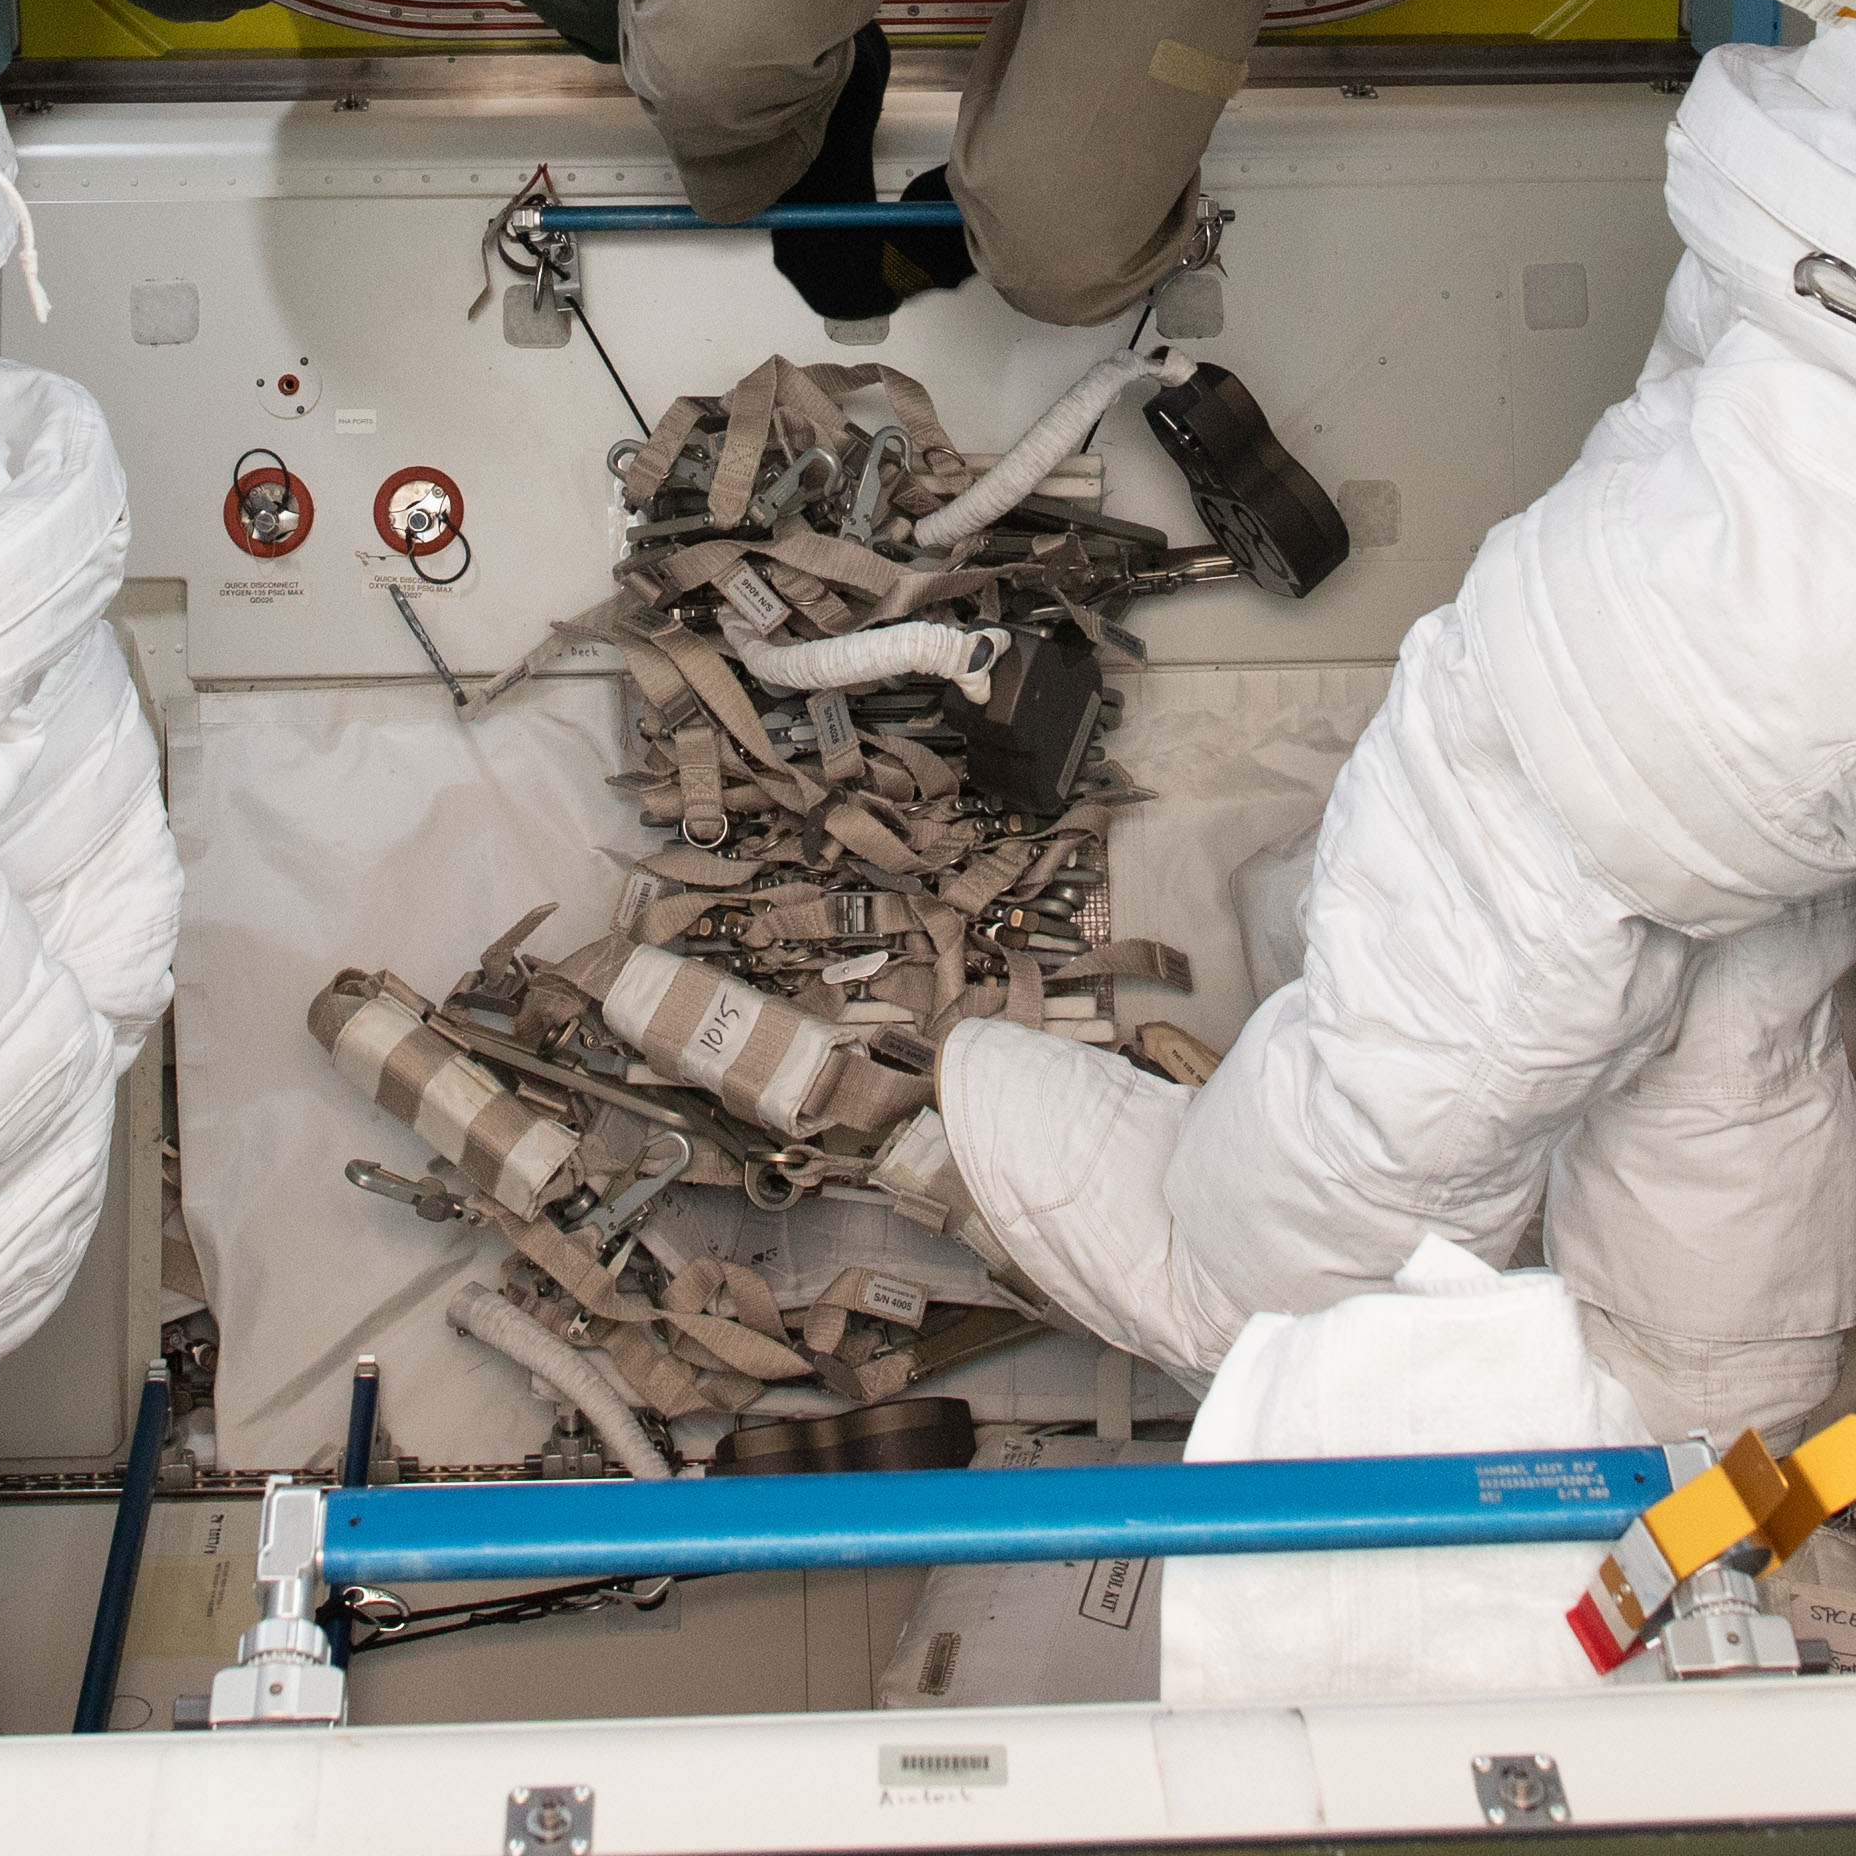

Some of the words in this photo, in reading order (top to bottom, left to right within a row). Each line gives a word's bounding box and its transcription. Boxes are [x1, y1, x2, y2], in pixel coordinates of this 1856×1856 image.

[224, 581, 248, 589] QUICK
[250, 581, 299, 589] DISCONNECT
[374, 575, 397, 584] QUICK
[740, 578, 760, 599] 4046
[758, 595, 775, 614] S/N
[823, 706, 835, 725] S/N
[700, 991, 741, 1055] 1015
[873, 1292, 891, 1305] S/N
[890, 1294, 913, 1312] 4005
[1107, 1558, 1130, 1591] TOOL
[1101, 1590, 1120, 1614] KIT
